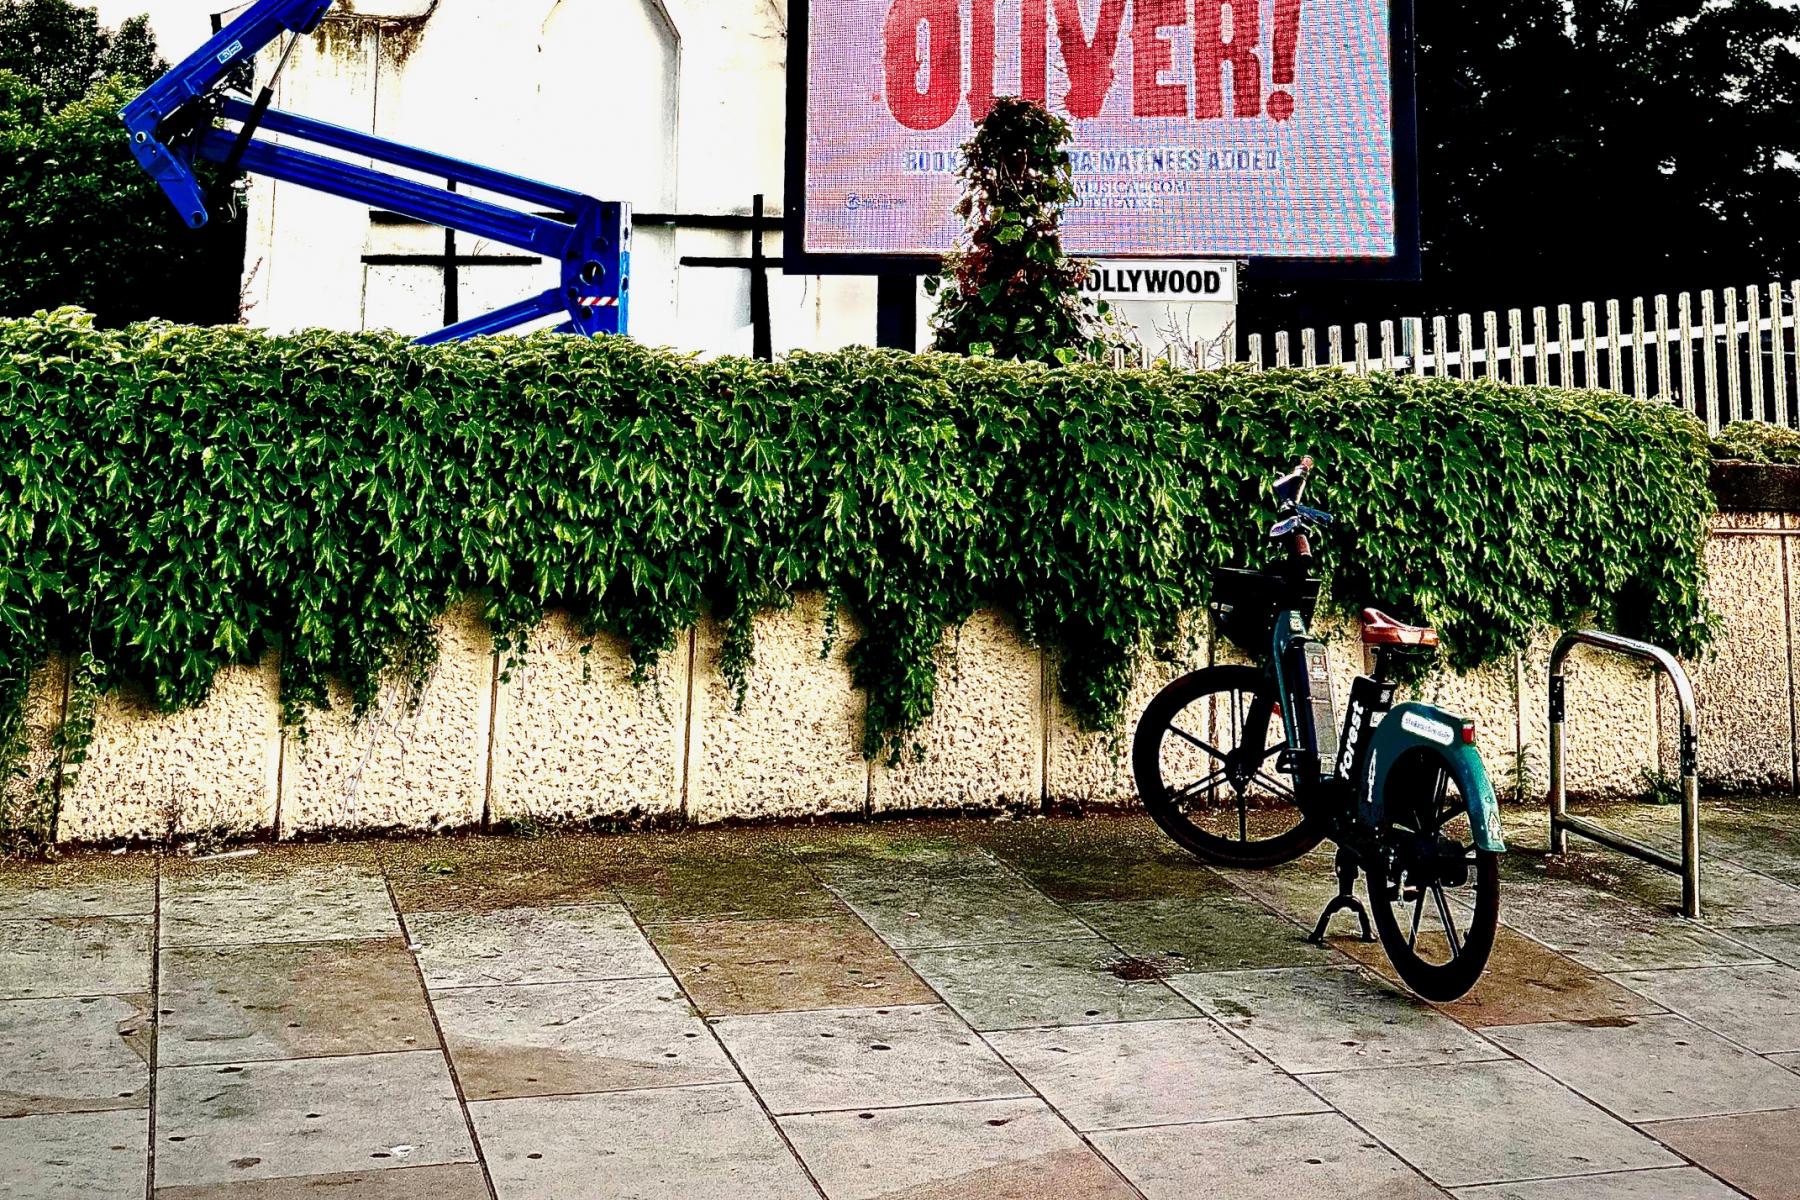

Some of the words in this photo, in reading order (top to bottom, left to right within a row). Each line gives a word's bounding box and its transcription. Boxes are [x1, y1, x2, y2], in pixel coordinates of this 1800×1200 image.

[1100, 150, 1200, 171] MATINEES
[1208, 149, 1277, 171] ADDED
[1079, 269, 1220, 293] OLLYWOOD
[1339, 700, 1363, 780] forest
